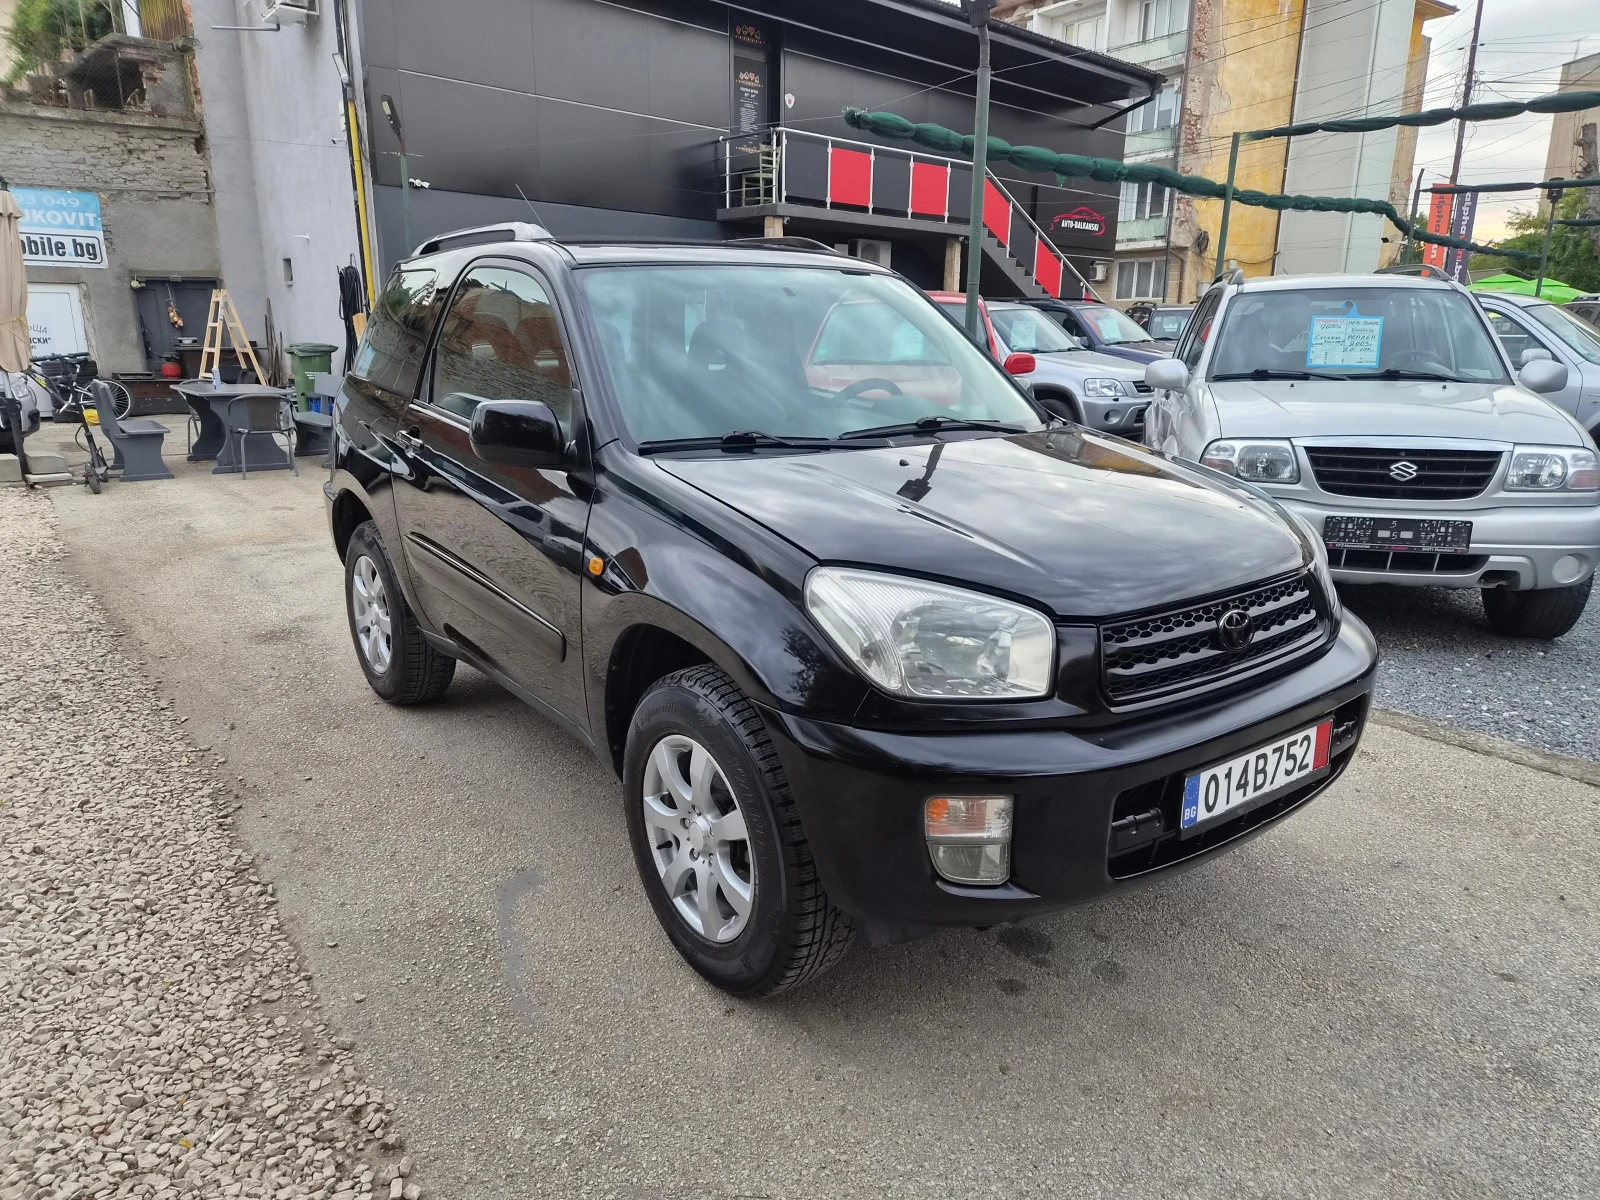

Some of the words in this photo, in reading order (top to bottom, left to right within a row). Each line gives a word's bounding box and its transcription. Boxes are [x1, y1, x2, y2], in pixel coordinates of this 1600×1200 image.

[43, 196, 80, 208] 049
[1204, 734, 1312, 813] 014B752
[1184, 806, 1197, 820] BG
